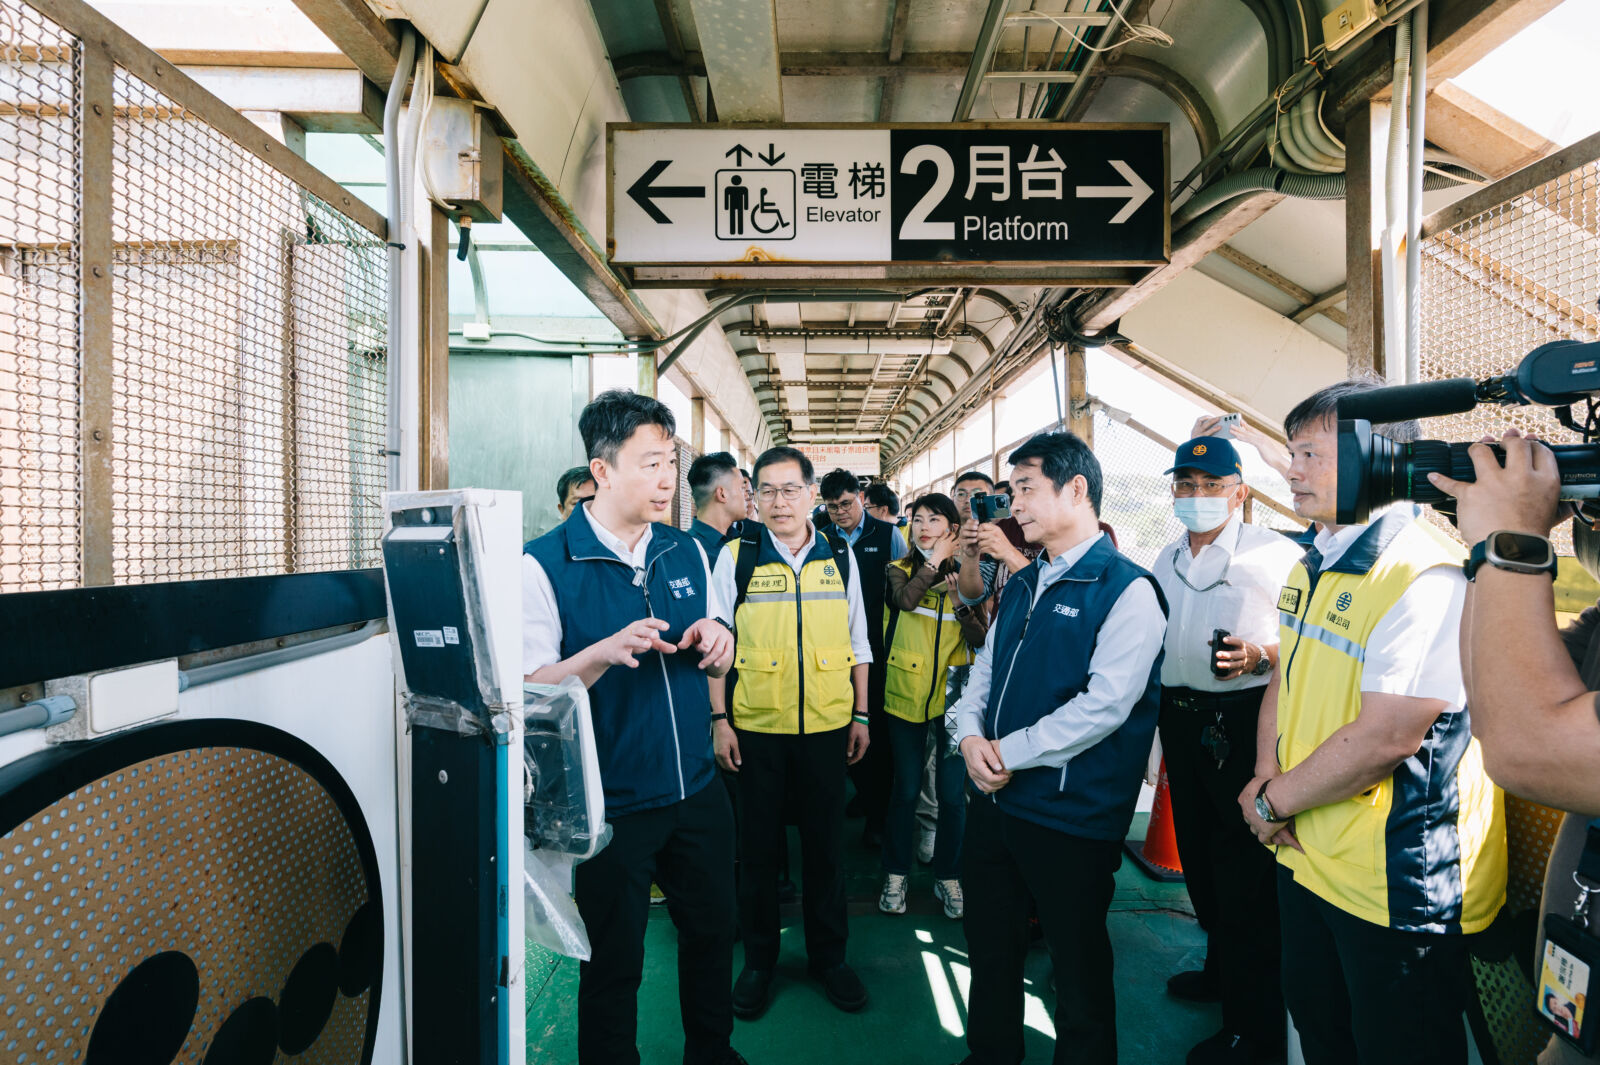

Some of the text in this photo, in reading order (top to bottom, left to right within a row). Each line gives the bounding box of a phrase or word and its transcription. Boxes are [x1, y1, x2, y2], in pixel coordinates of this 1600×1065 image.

[800, 161, 886, 200] 電梯
[964, 144, 1067, 202] 月台
[898, 144, 956, 240] 2
[806, 206, 881, 223] Elevator
[963, 215, 1069, 241] Platform
[669, 576, 691, 589] 交通部
[1052, 603, 1080, 617] 交通部
